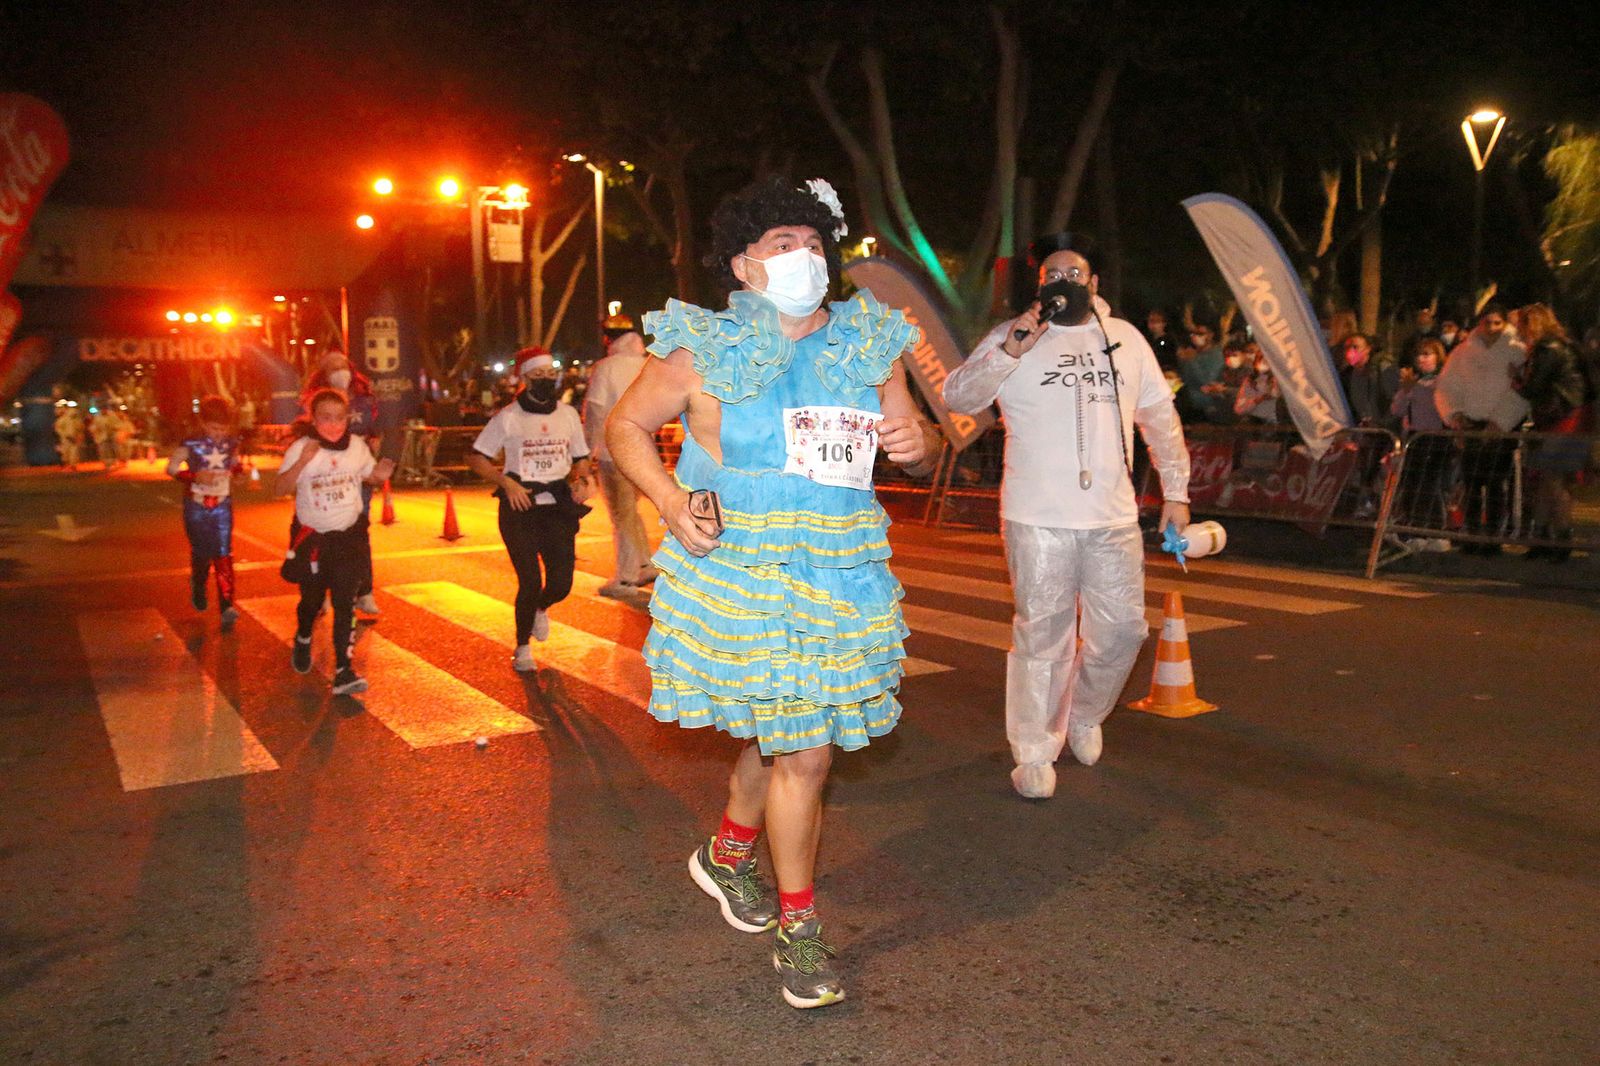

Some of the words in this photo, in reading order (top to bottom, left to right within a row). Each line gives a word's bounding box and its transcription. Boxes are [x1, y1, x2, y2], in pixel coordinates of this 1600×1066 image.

[79, 337, 242, 361] DECATHLON
[818, 443, 853, 463] 106
[534, 461, 553, 470] 709
